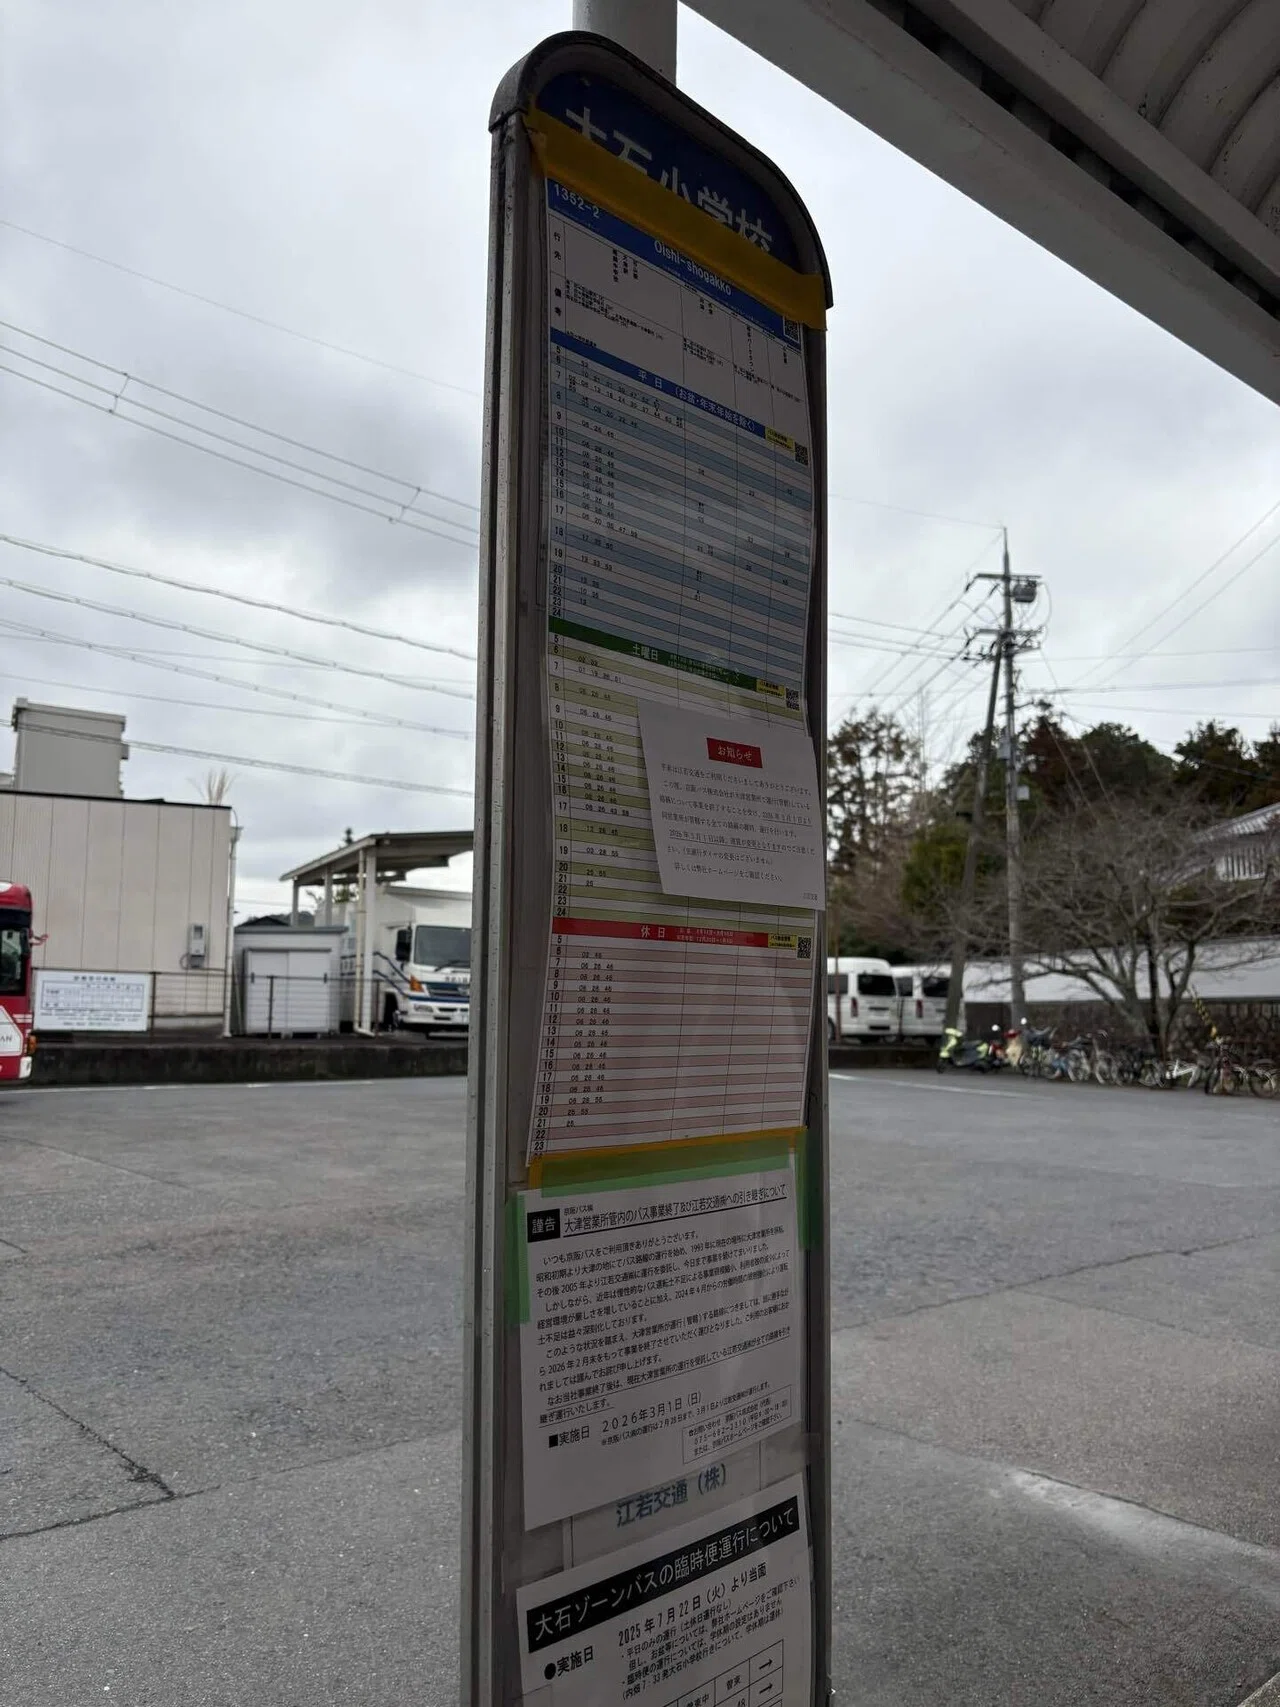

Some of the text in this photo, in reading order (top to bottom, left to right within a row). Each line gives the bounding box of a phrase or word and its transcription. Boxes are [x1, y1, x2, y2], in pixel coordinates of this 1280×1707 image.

[553, 183, 600, 219] 1352-2
[654, 239, 732, 296] Oishi-shogakko
[633, 642, 659, 661] 土曜日
[555, 720, 563, 728] 10
[556, 732, 563, 740] 11
[556, 742, 564, 750] 12
[557, 753, 565, 761] 13
[717, 745, 753, 762] お知らせ
[557, 764, 565, 772] 14
[558, 775, 566, 783] 15
[558, 786, 566, 794] 16
[559, 802, 567, 810] 17
[560, 846, 568, 854] 19
[559, 862, 568, 871] 20
[559, 874, 567, 882] 21
[558, 885, 567, 894] 22
[558, 896, 566, 905] 23
[557, 908, 566, 916] 24
[551, 992, 559, 1000] 10
[550, 1004, 557, 1012] 11
[549, 1015, 557, 1024] 12
[547, 1026, 556, 1035] 13
[546, 1038, 555, 1046] 14
[545, 1049, 554, 1058] 15
[544, 1061, 553, 1070] 16
[543, 1073, 552, 1081] 17
[542, 1084, 550, 1093] 18
[541, 1095, 549, 1104] 19
[538, 1107, 548, 1116] 20
[537, 1119, 546, 1127] 21
[536, 1130, 545, 1139] 22
[534, 1142, 544, 1150] 23
[531, 1216, 556, 1235] 謹告
[616, 1478, 689, 1528] 江若交通
[533, 1507, 795, 1643] 大石ゾーンバスの臨時便運行について
